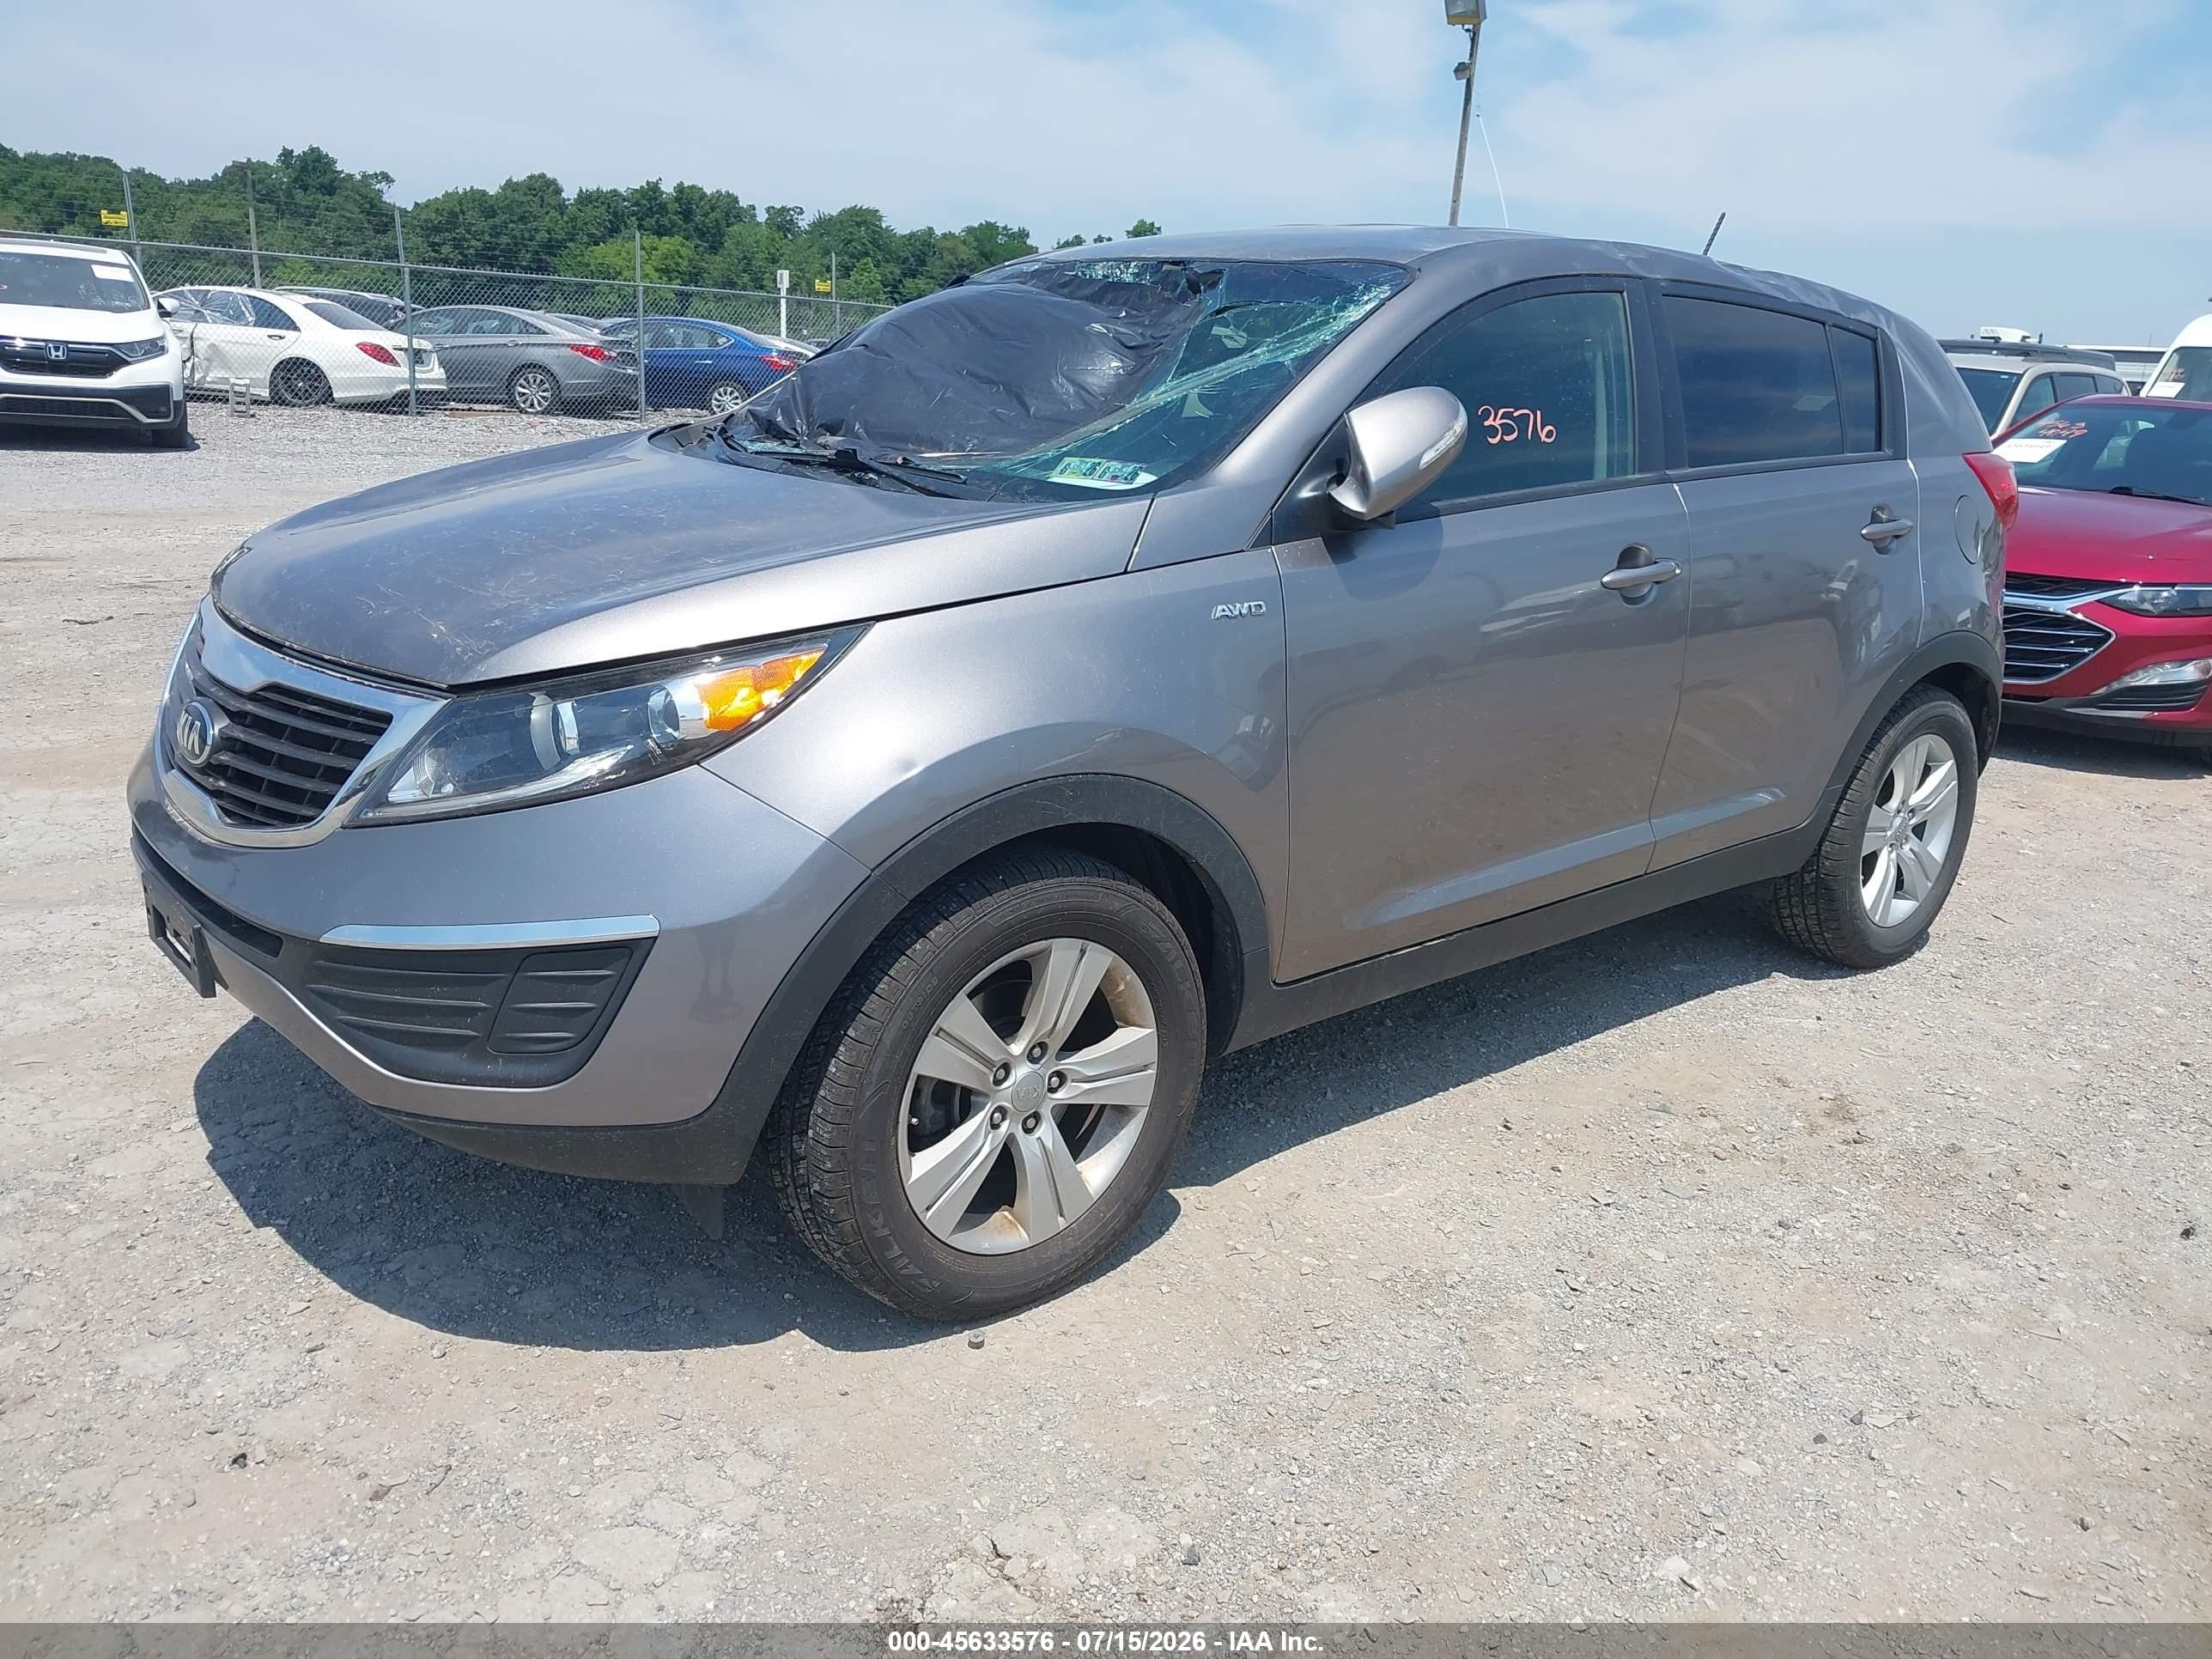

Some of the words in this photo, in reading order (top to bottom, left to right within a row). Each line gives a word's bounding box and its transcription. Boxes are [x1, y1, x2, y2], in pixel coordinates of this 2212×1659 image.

[1478, 405, 1557, 444] 3576
[1211, 600, 1267, 619] AWD
[177, 710, 201, 756] KIA
